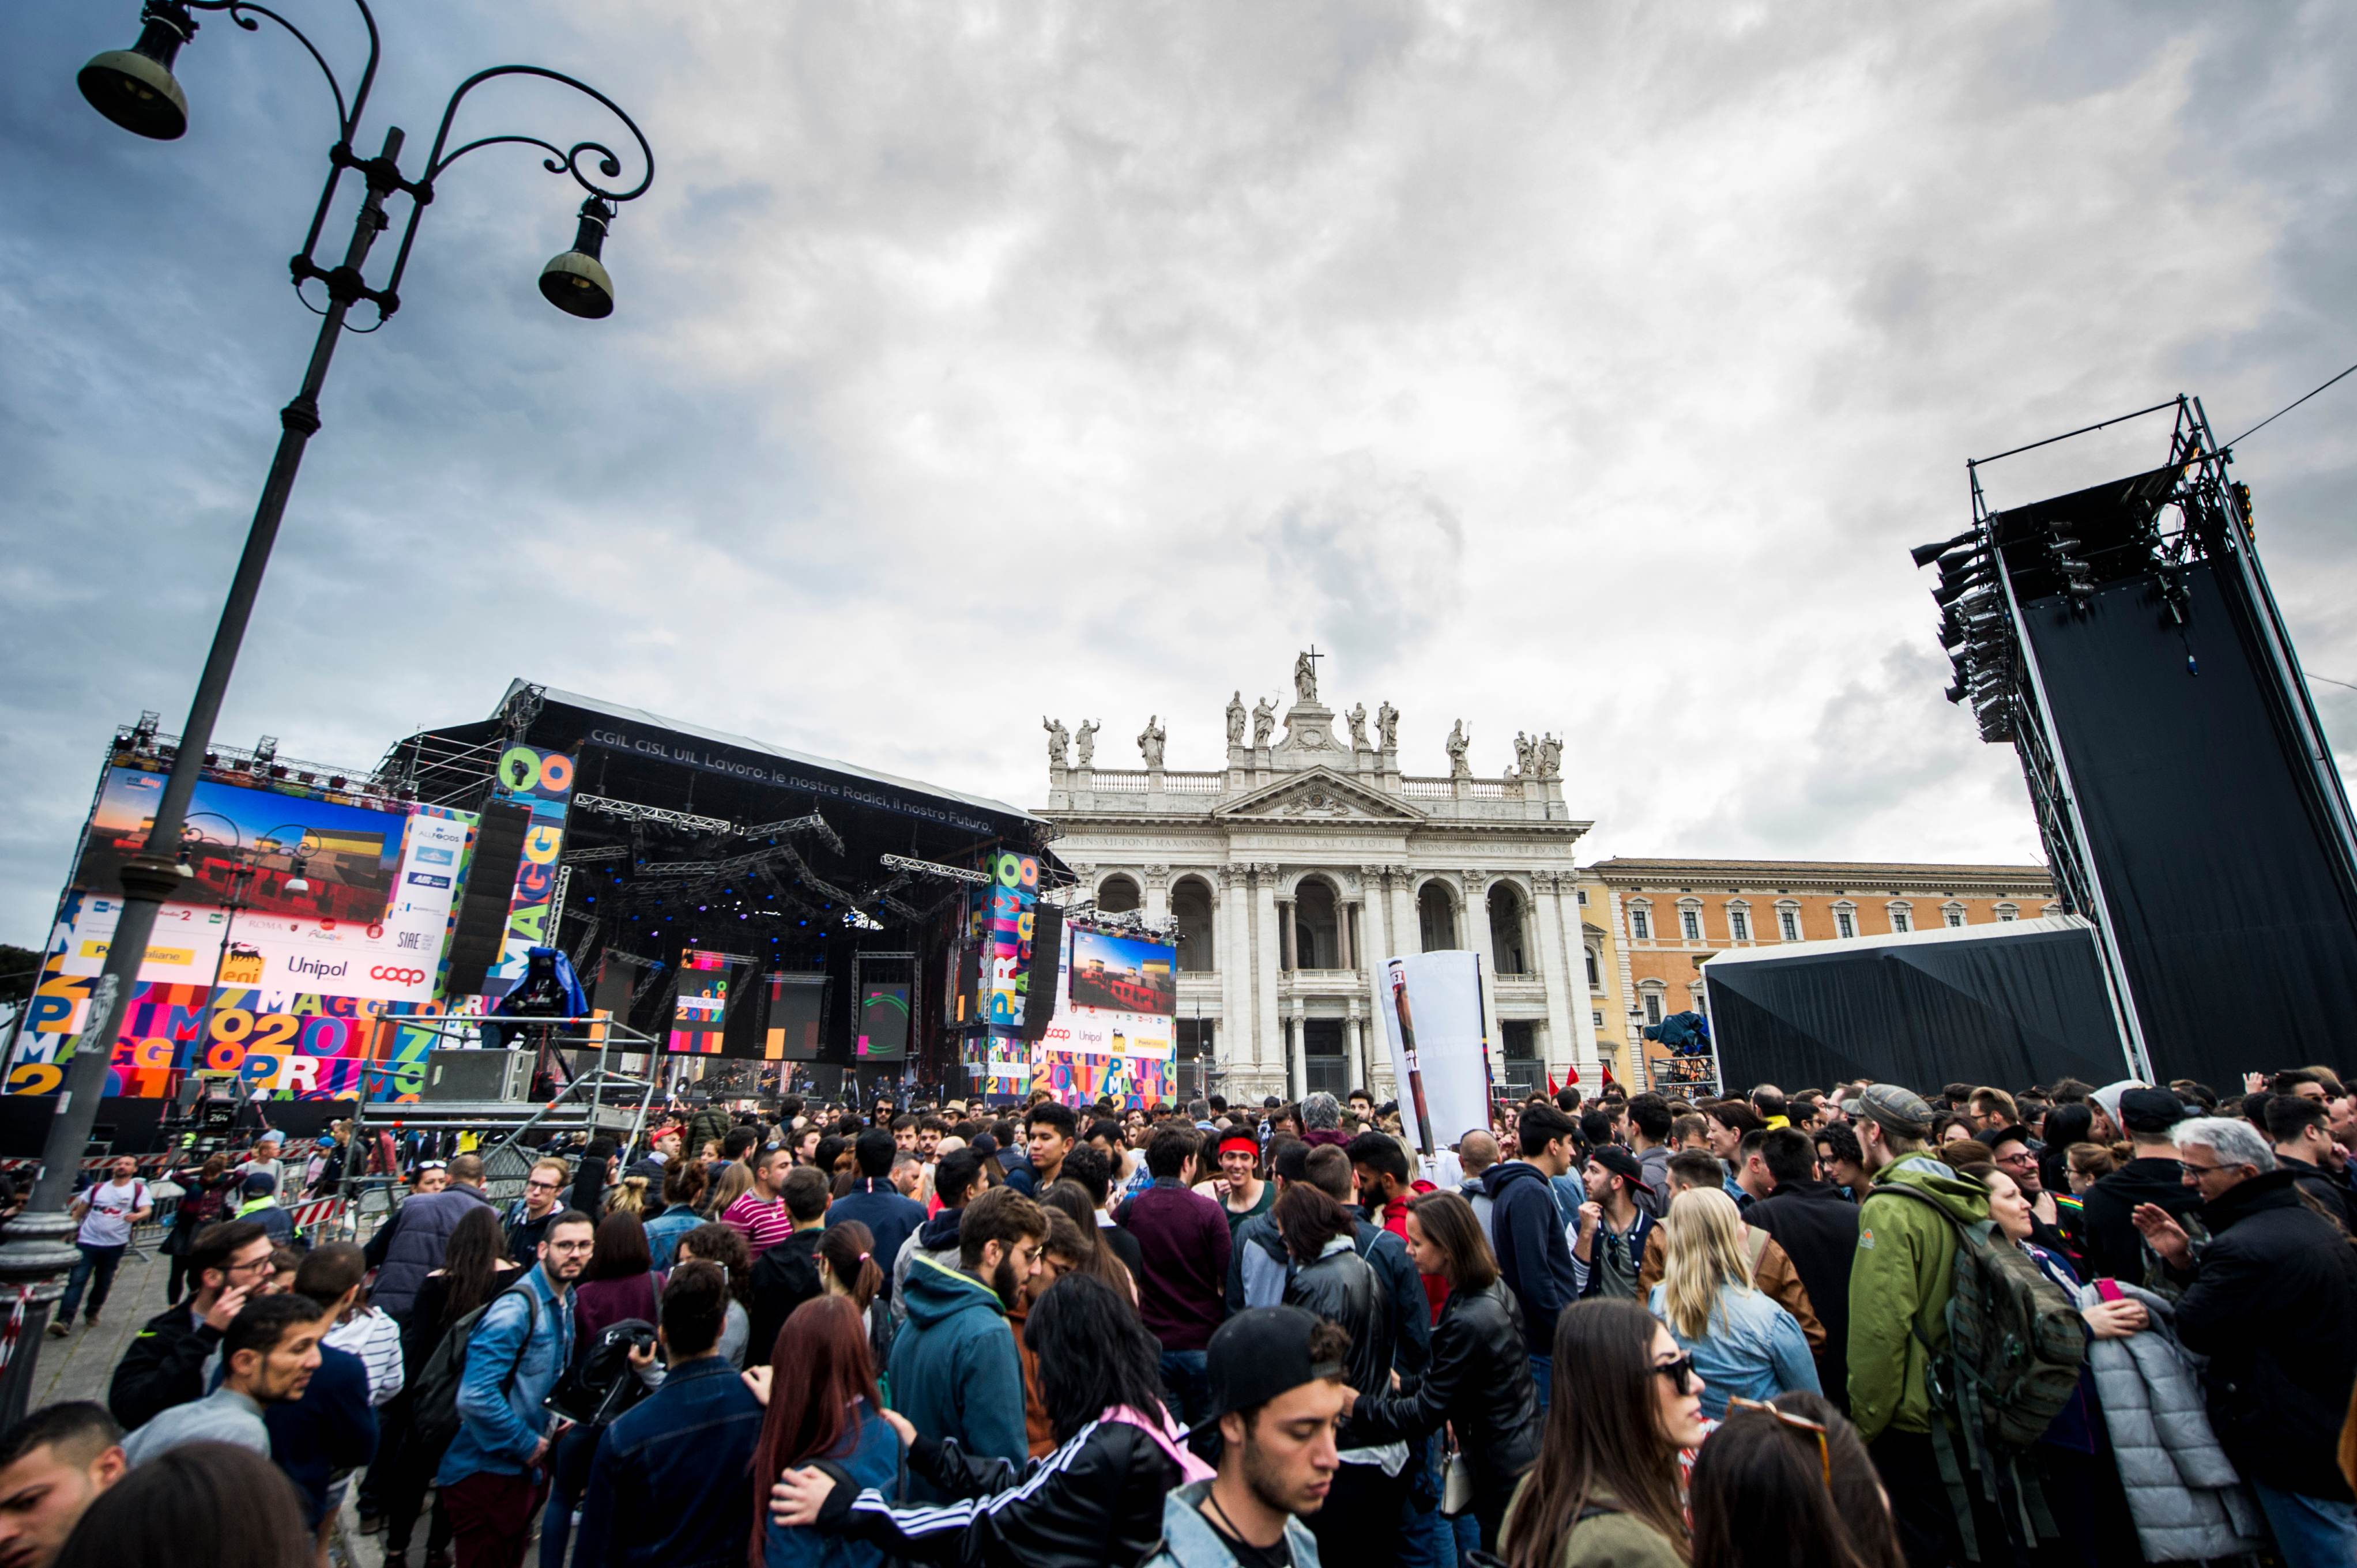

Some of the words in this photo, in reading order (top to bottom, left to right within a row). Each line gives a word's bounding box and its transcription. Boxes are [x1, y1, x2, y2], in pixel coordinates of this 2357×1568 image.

[592, 729, 630, 748] CGIL
[635, 740, 669, 757] CISL
[674, 748, 698, 764] UIL
[705, 753, 767, 779] Lavoro:
[772, 770, 786, 783] le
[790, 775, 839, 795] nostre
[844, 786, 890, 808] Radici,
[893, 797, 901, 809] il
[903, 802, 946, 820] nostro
[948, 811, 993, 832] Futuro.
[1122, 838, 1150, 847] PONT
[1155, 839, 1179, 847] MAX
[1184, 839, 1215, 848] ANNO
[1246, 837, 1308, 847] CHRISTO
[180, 910, 192, 921] 2
[248, 920, 283, 932] ROMA
[397, 931, 421, 949] SIAE
[144, 950, 180, 962] aliane
[223, 968, 259, 984] eni
[288, 955, 348, 980] Unipol
[370, 965, 426, 987] coop
[675, 1007, 724, 1022] 2017
[247, 1013, 437, 1062] 2017
[1046, 1028, 1070, 1041] coop
[1079, 1030, 1102, 1044] Unipol
[989, 1036, 1030, 1053] PRIMO
[1031, 1042, 1110, 1067] MAGGIO
[1109, 1057, 1176, 1081] PRIMO
[987, 1076, 1030, 1095] 2017
[1031, 1063, 1110, 1093] 2017
[1108, 1076, 1177, 1095] MAGGIO
